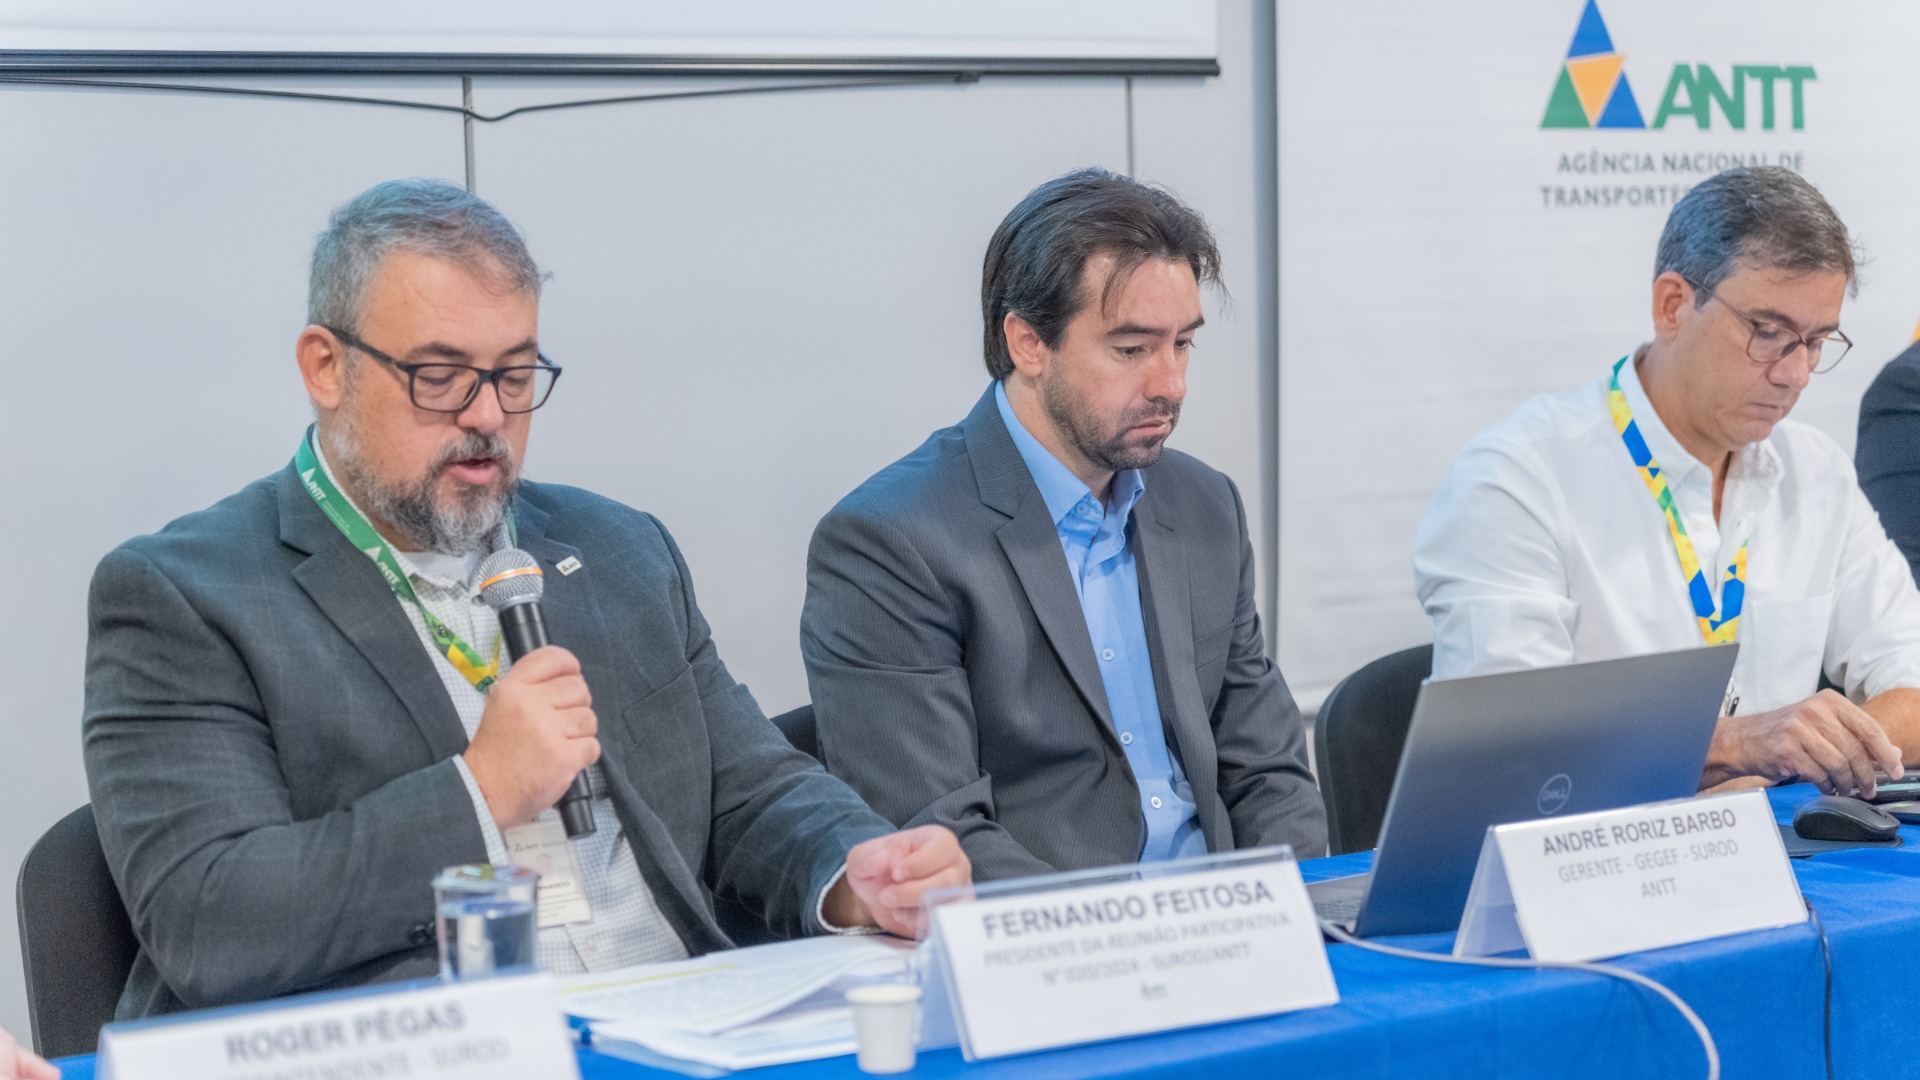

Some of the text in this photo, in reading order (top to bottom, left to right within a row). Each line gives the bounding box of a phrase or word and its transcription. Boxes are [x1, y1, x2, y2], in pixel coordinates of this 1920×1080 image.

[1652, 63, 1817, 130] ANTT
[1557, 148, 1656, 174] AGÊNCIA
[1779, 152, 1804, 173] DE
[307, 480, 327, 501] ANTT
[377, 561, 400, 584] ANTT
[1543, 808, 1737, 856] ANDRÉ RORIZ BARBO
[1558, 857, 1624, 883] GERENTE
[1634, 847, 1679, 870] GEGEF
[1689, 838, 1739, 861] SUROD
[982, 879, 1275, 940] FERNANDO FEITOSA
[1641, 877, 1678, 898] ANTT
[224, 999, 466, 1065] ROGER PÉGAS
